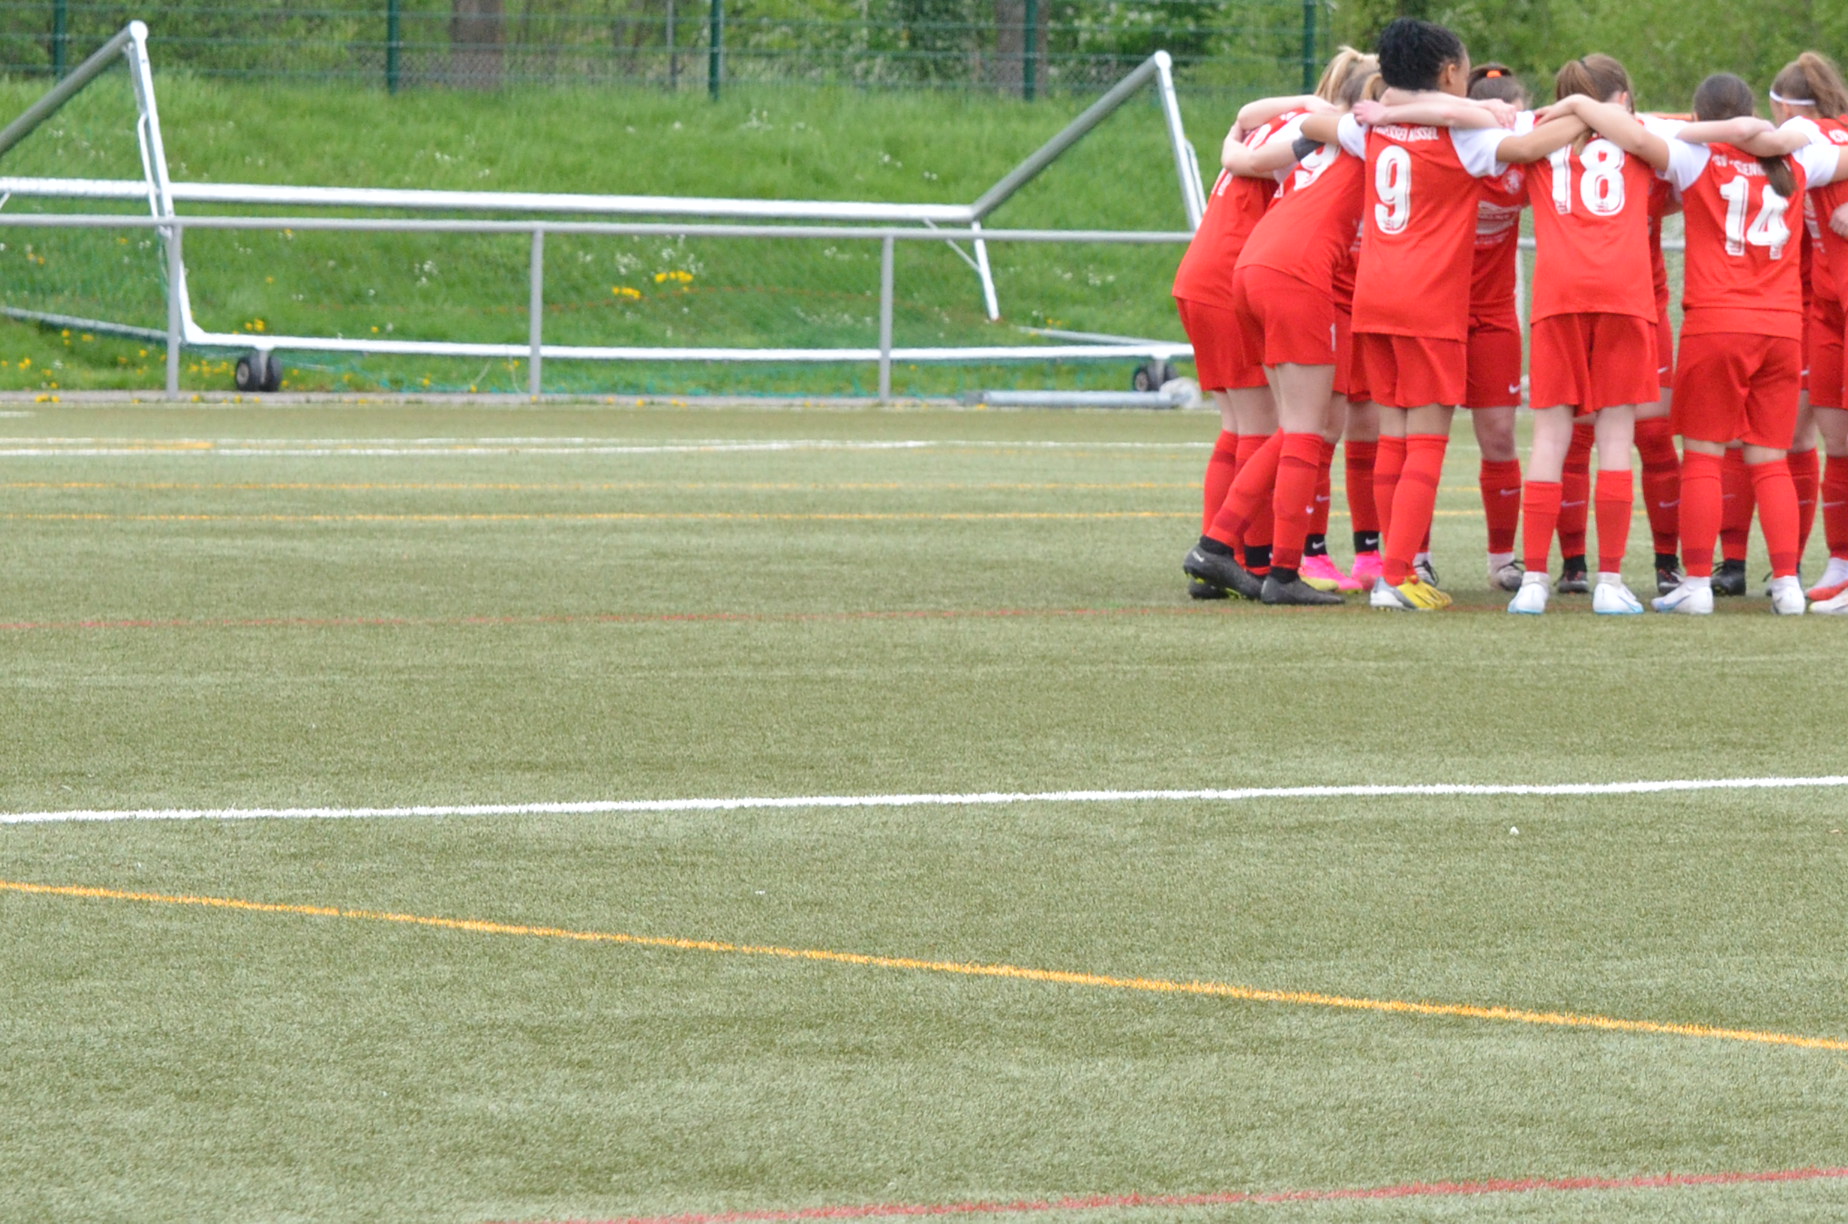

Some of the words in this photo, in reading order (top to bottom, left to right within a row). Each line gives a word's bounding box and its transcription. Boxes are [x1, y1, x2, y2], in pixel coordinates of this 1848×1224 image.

[1374, 144, 1412, 235] 9
[1548, 138, 1626, 216] 18
[1719, 175, 1792, 260] 14
